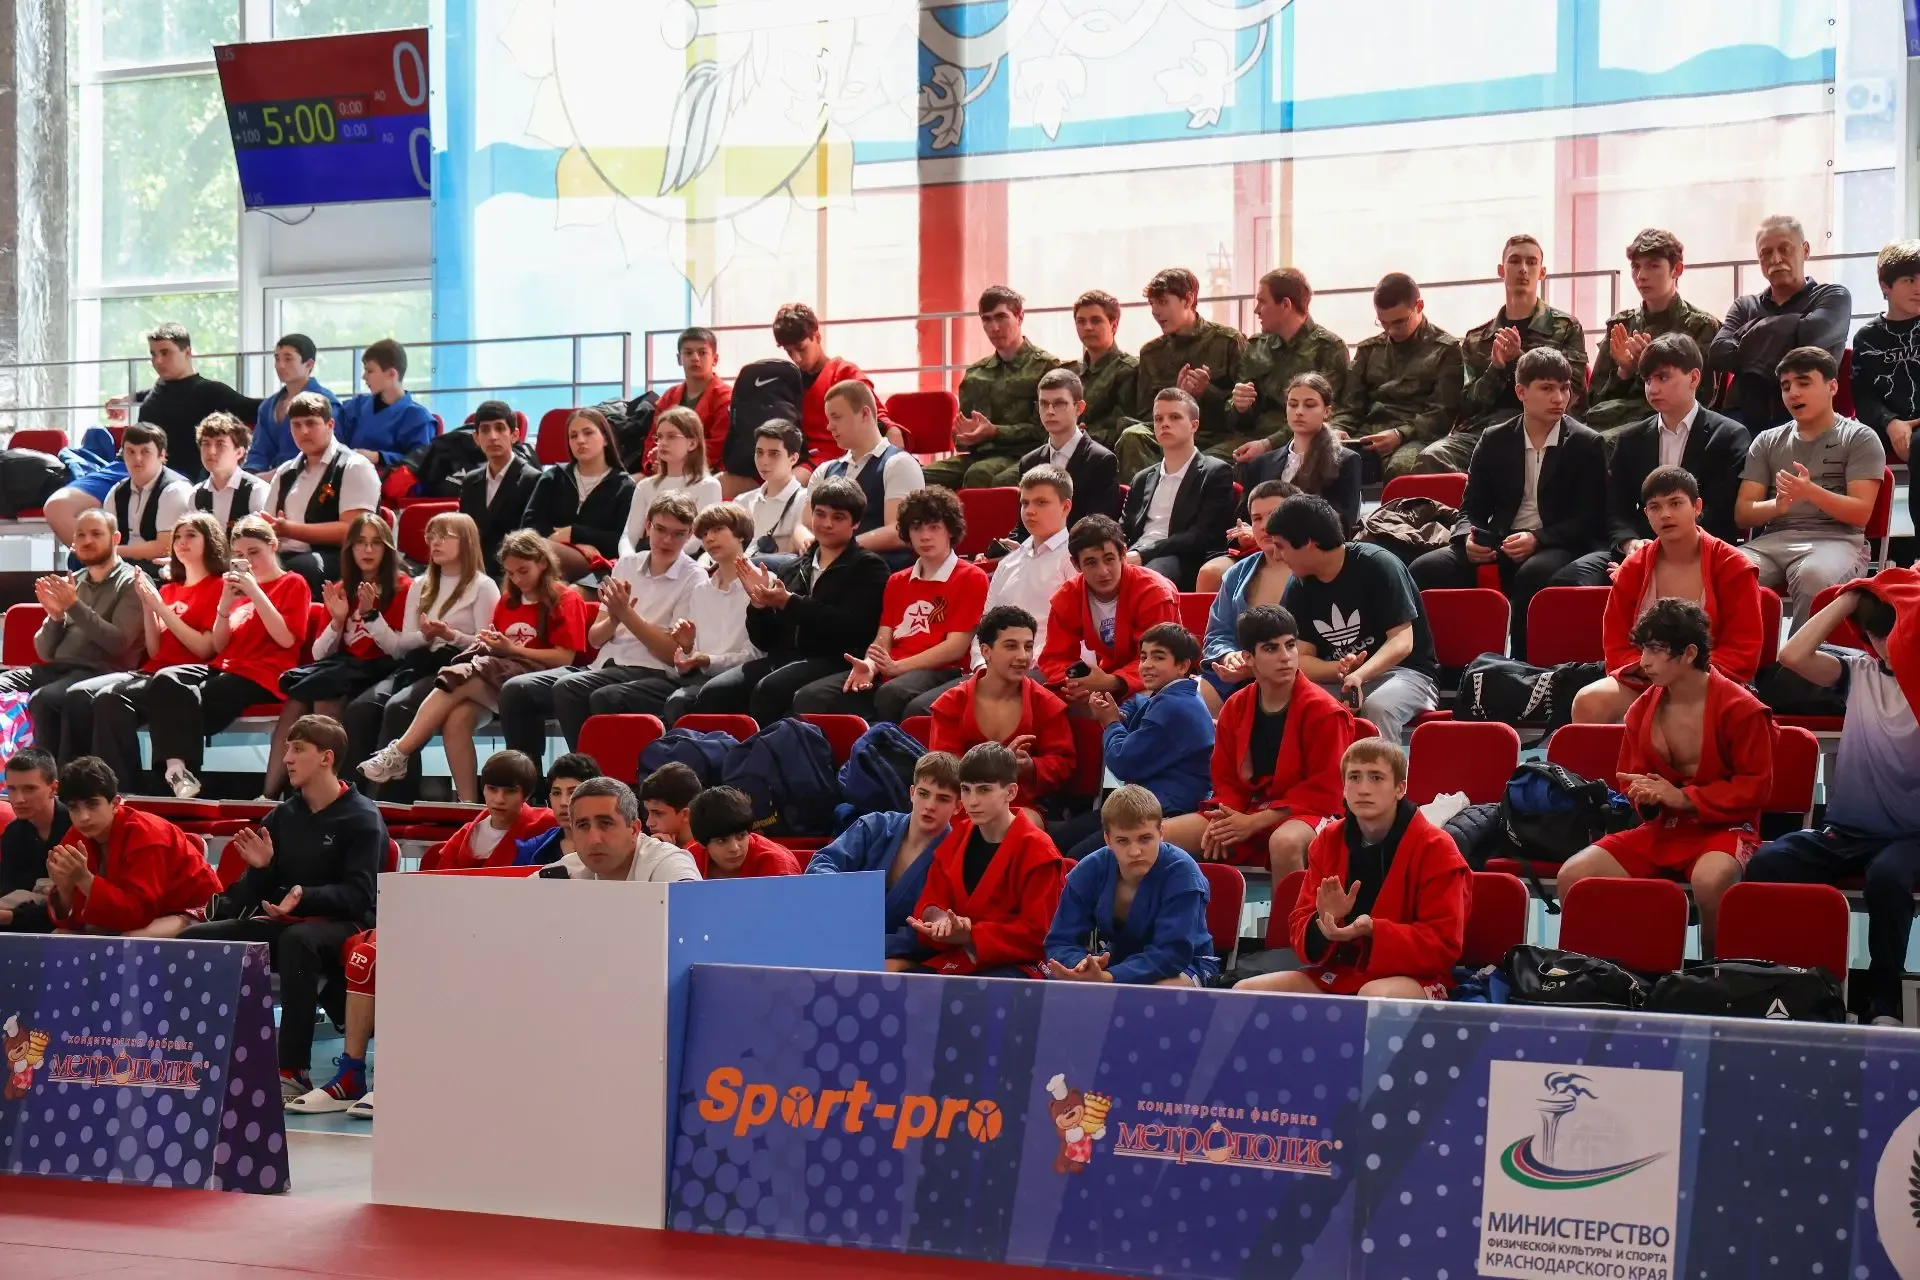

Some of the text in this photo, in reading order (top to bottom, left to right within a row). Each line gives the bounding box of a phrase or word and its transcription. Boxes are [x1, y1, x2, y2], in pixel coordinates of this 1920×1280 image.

[393, 41, 427, 106] 0
[339, 100, 363, 115] 0:00
[262, 103, 335, 145] 5:00
[343, 123, 367, 137] 0:00
[147, 1036, 194, 1051] фабрика
[698, 1066, 1003, 1149] Sport-pro
[1137, 1100, 1318, 1127] кондитерская фабрика
[1487, 1211, 1670, 1248] МИНИСТЕРСТВО
[1487, 1238, 1667, 1264] ФИЗИЧЕСКОЙ КУЛЬТУРЫ И СПОРТА
[1486, 1252, 1668, 1280] КРАСНОДАРСКОГО КРАЯ
